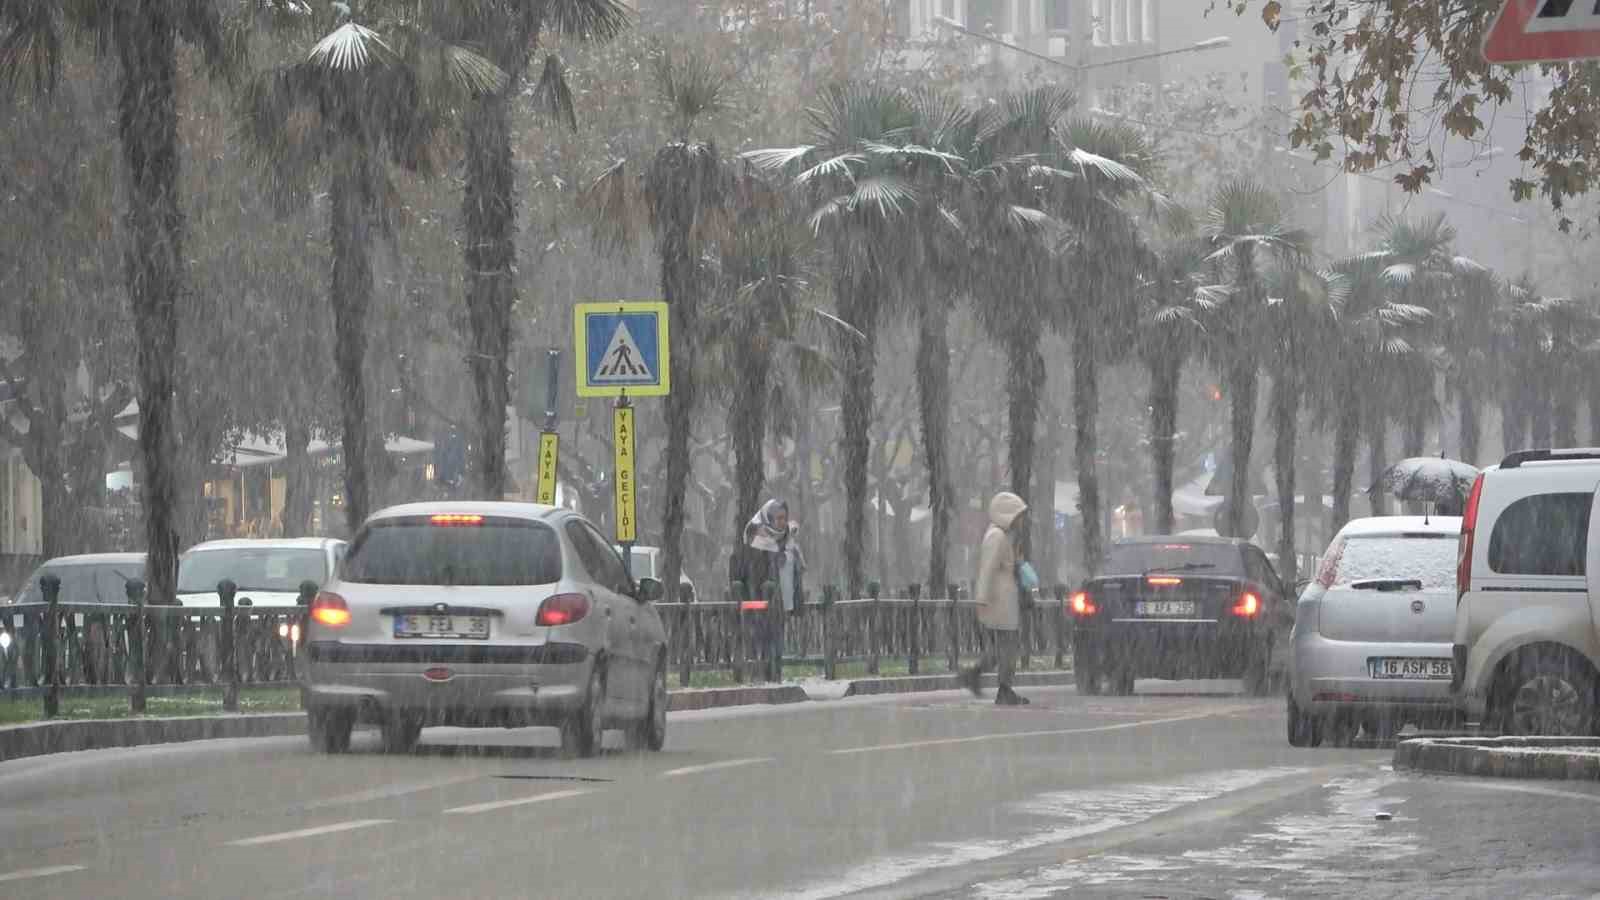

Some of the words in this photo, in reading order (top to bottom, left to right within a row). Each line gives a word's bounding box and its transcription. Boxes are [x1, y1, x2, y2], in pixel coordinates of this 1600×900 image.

[620, 411, 628, 456] YAYA
[544, 439, 553, 480] YAYA
[1384, 661, 1398, 674] 16
[1402, 661, 1428, 674] ASM
